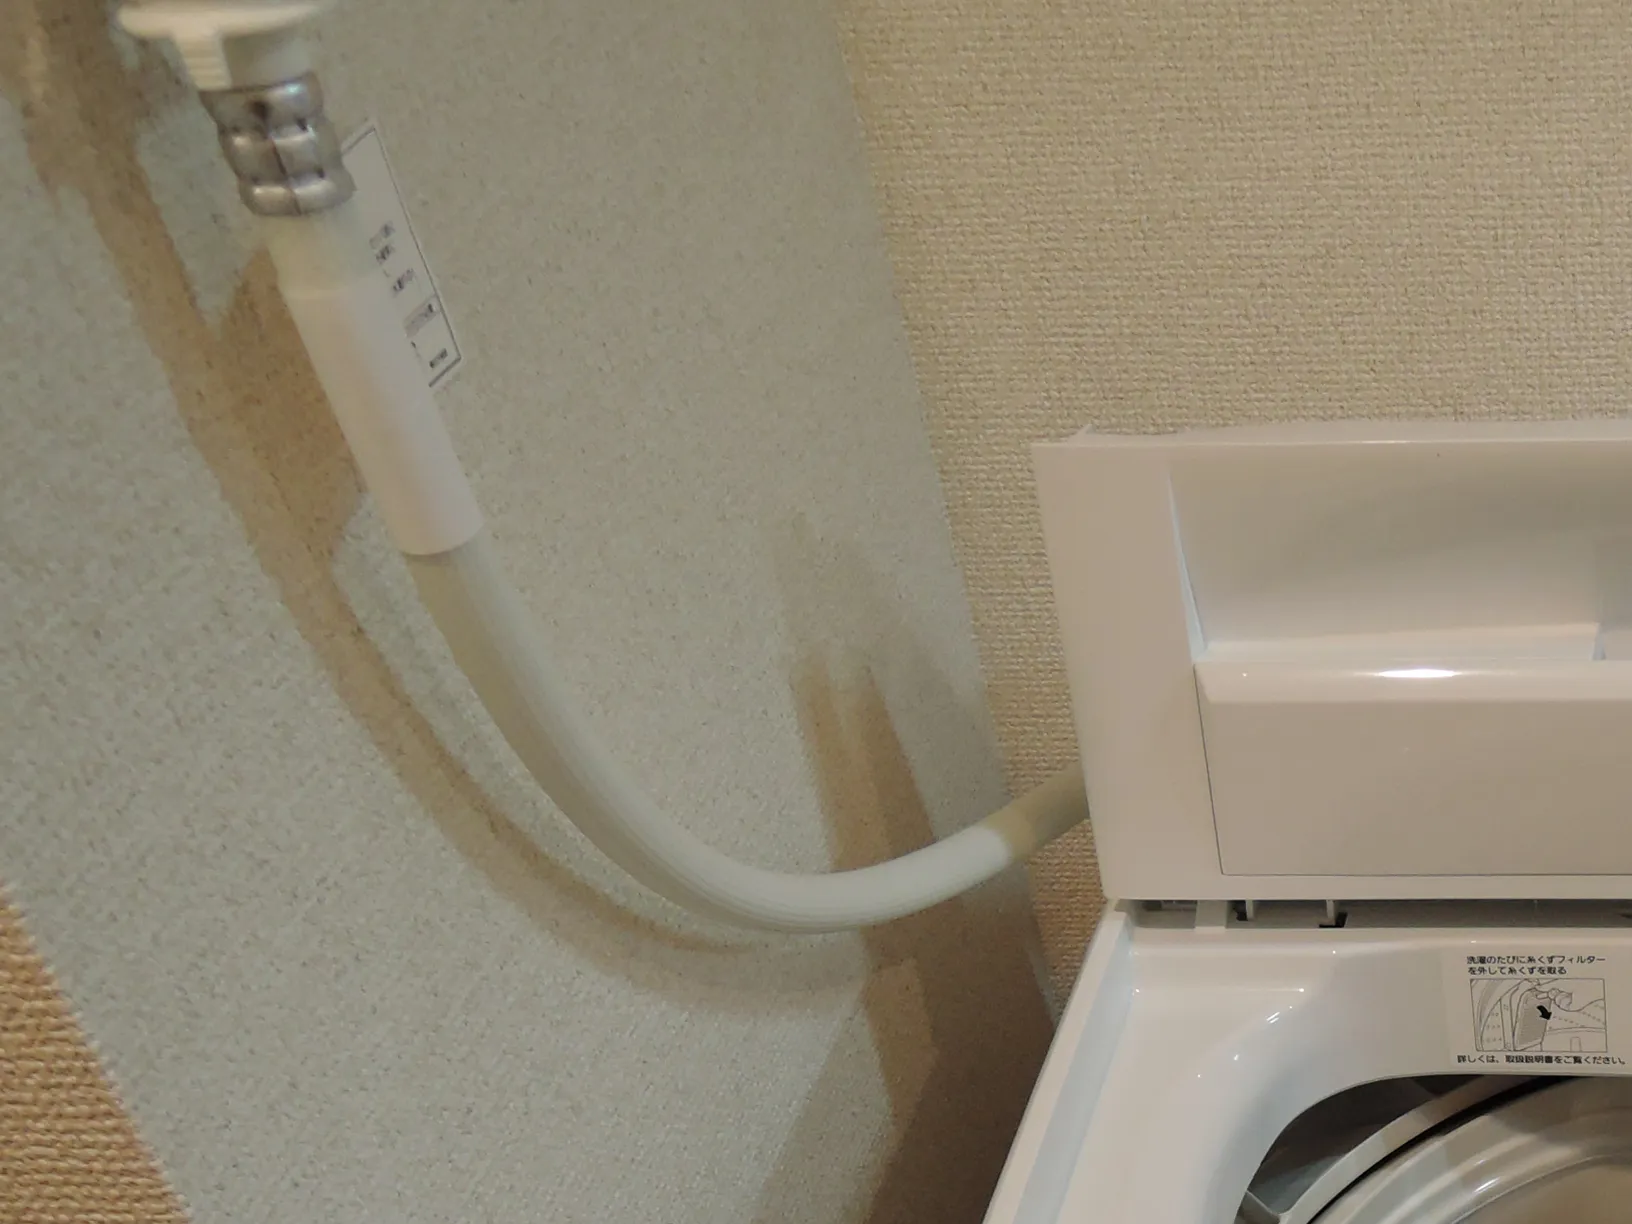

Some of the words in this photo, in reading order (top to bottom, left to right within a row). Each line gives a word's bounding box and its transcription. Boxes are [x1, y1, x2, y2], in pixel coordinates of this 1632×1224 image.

[1466, 955, 1606, 965] 洗濯のたびに糸くずフィルター
[1467, 966, 1568, 975] を外して糸くずを取る
[1457, 1054, 1627, 1065] 詳しくは、取扱説明書をご覧ください。
